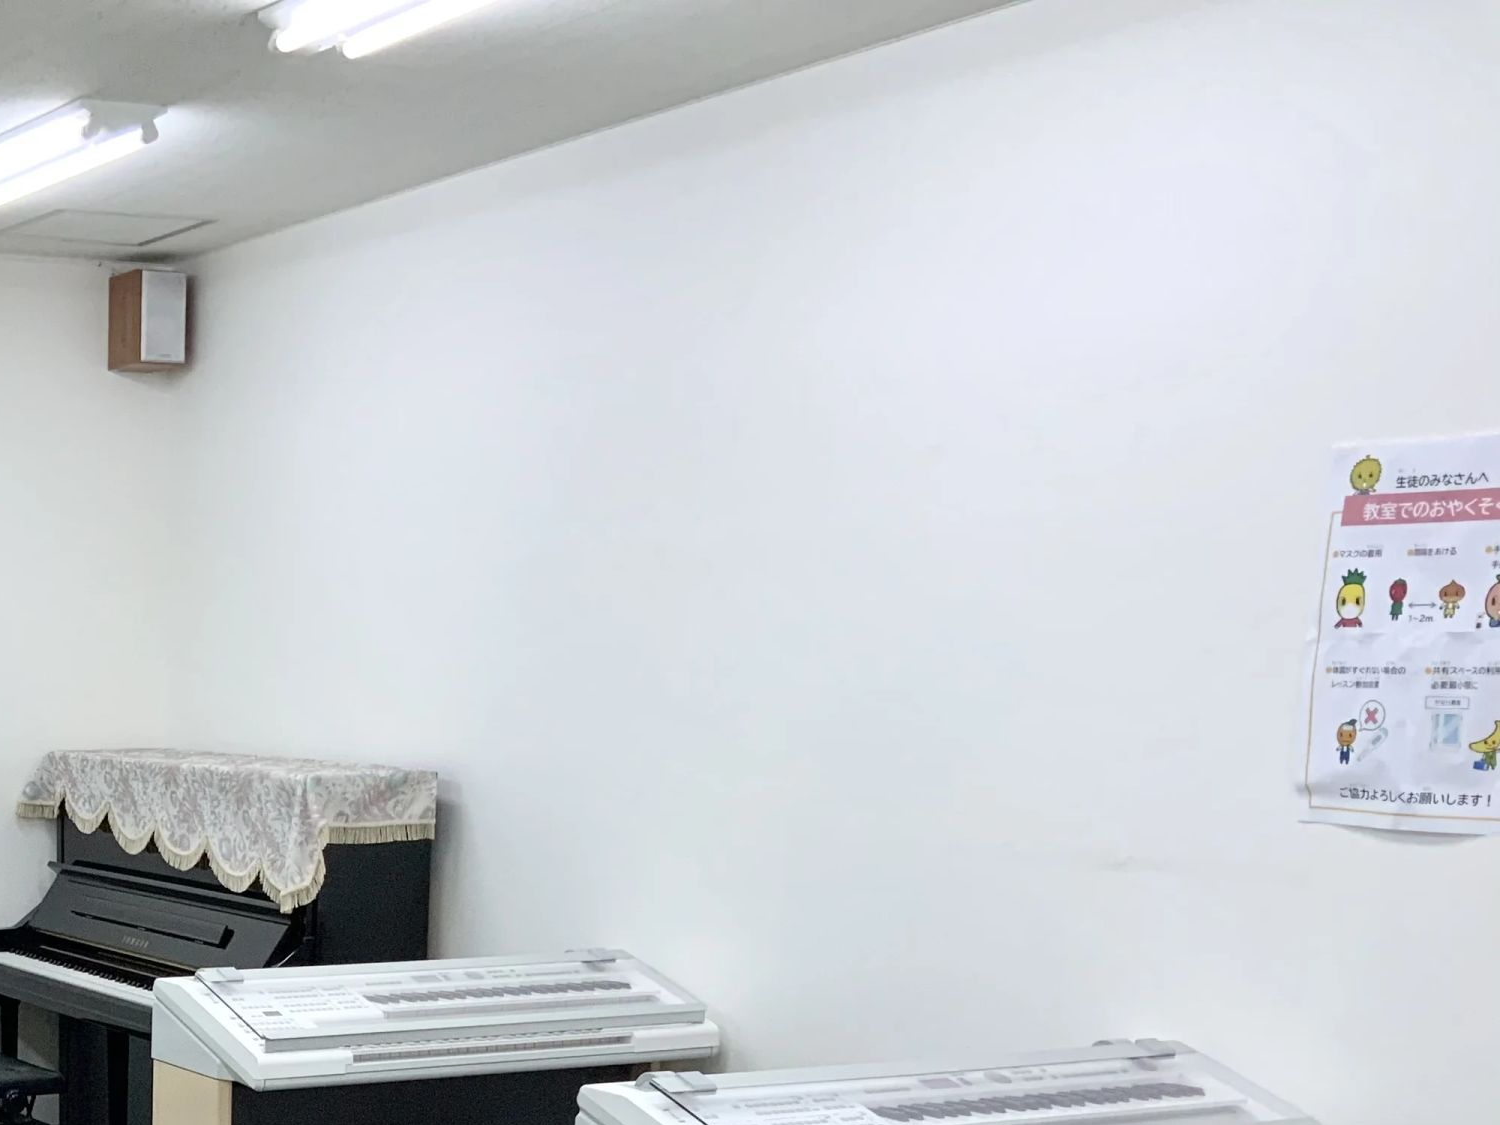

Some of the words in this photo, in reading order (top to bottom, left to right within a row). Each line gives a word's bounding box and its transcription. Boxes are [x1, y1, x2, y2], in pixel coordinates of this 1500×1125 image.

[1396, 472, 1489, 488] 生徒のみなさんへ
[1339, 787, 1492, 807] ご協力よろしくお願いします！
